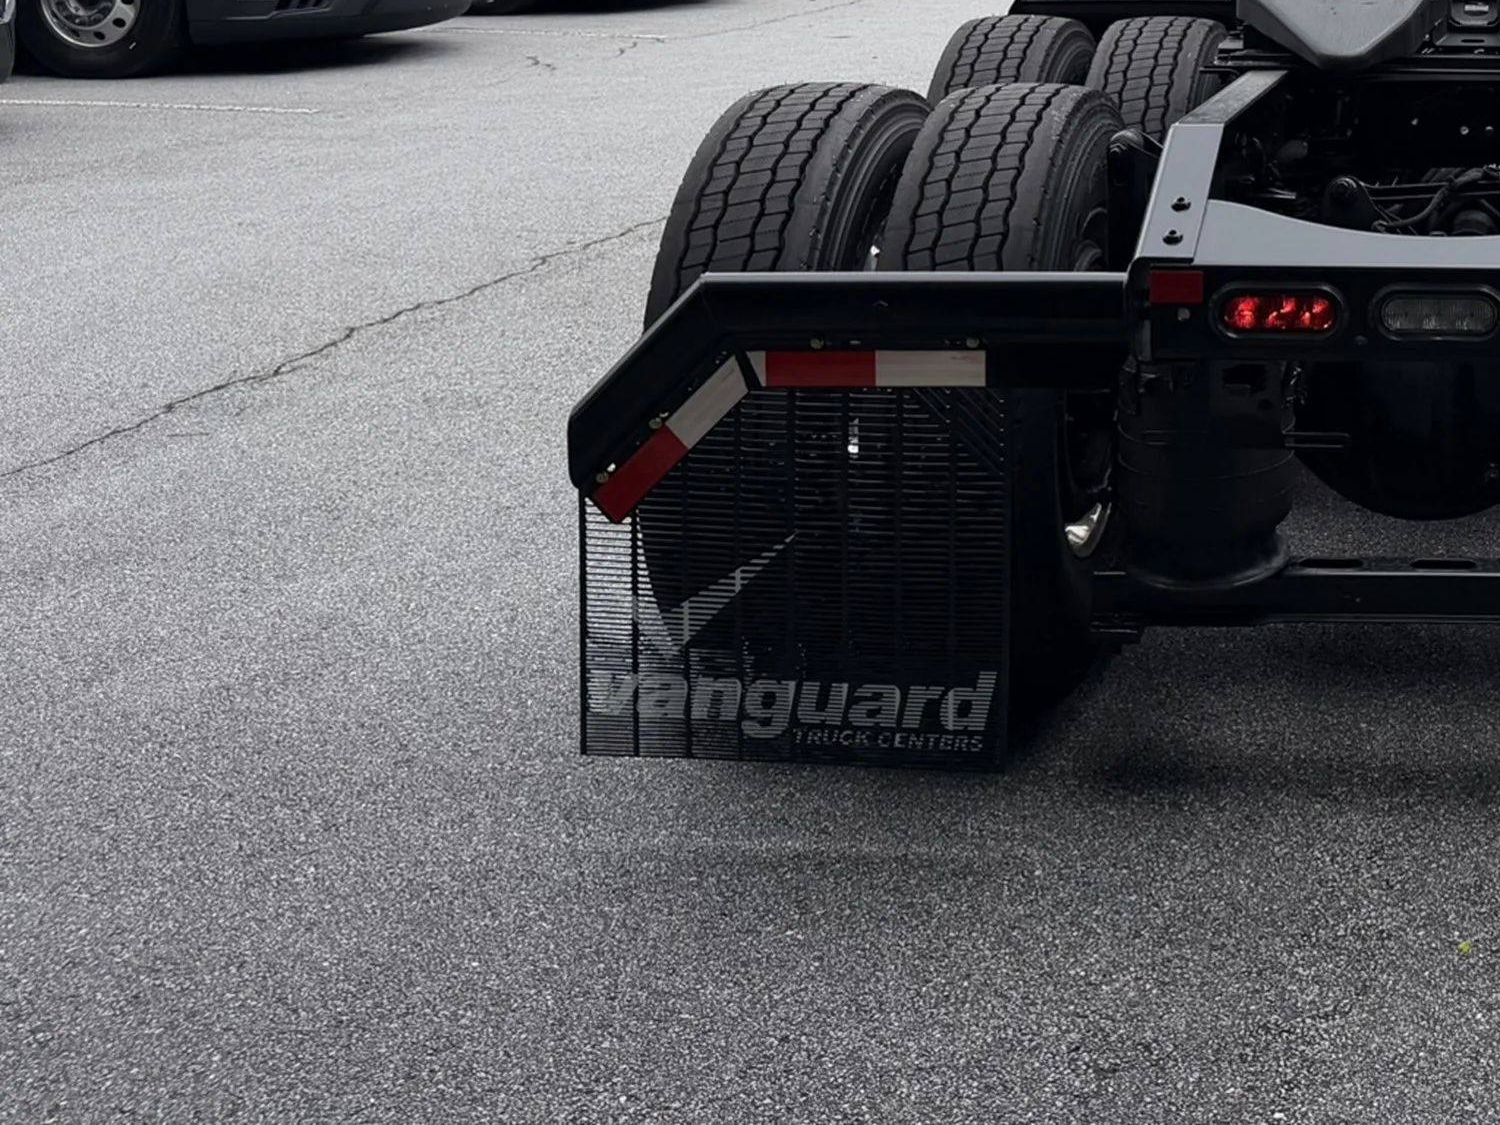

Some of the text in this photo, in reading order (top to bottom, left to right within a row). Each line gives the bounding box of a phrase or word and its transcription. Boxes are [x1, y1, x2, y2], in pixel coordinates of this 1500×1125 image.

[587, 671, 998, 738] vanguard
[793, 728, 984, 752] TRUCK CENTERS
